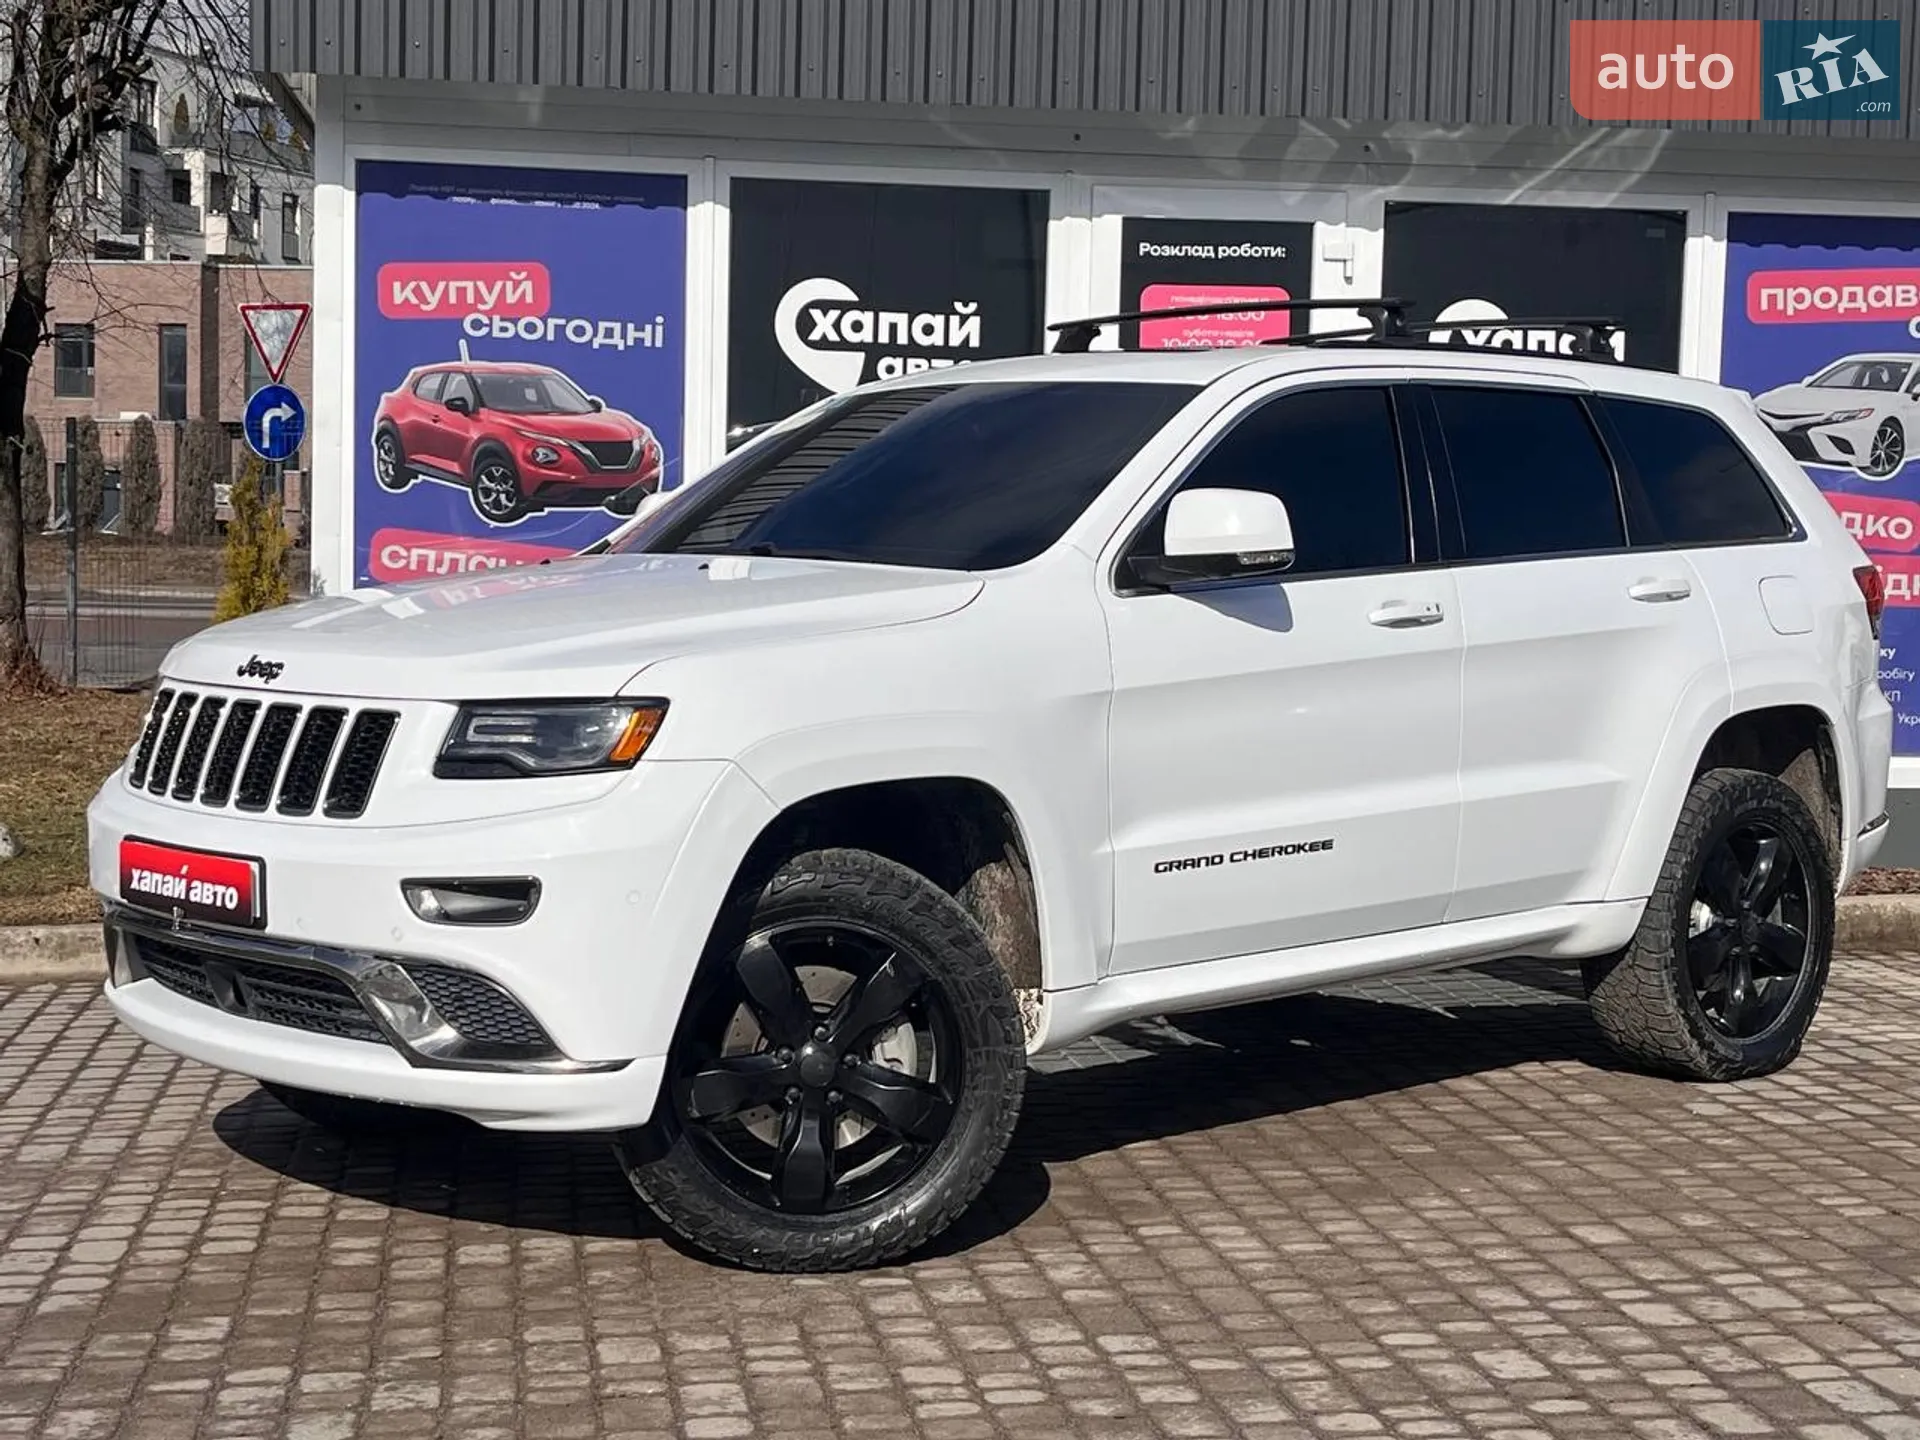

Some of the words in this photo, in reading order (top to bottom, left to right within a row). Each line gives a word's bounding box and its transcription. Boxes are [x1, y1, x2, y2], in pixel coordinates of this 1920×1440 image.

[1139, 242, 1215, 258] Розклад
[1218, 243, 1287, 258] роботи:
[392, 271, 534, 311] купуй
[1760, 284, 1920, 316] продав
[462, 312, 665, 350] сьогодні
[807, 301, 981, 348] хапай
[876, 356, 973, 381] ав
[380, 545, 524, 575] спла
[237, 654, 285, 684] Jeep
[1897, 712, 1920, 726] Укр
[1154, 854, 1224, 874] GRAND
[1229, 839, 1335, 863] CHEROKEE
[130, 864, 188, 900] хапай
[189, 880, 239, 910] авто
